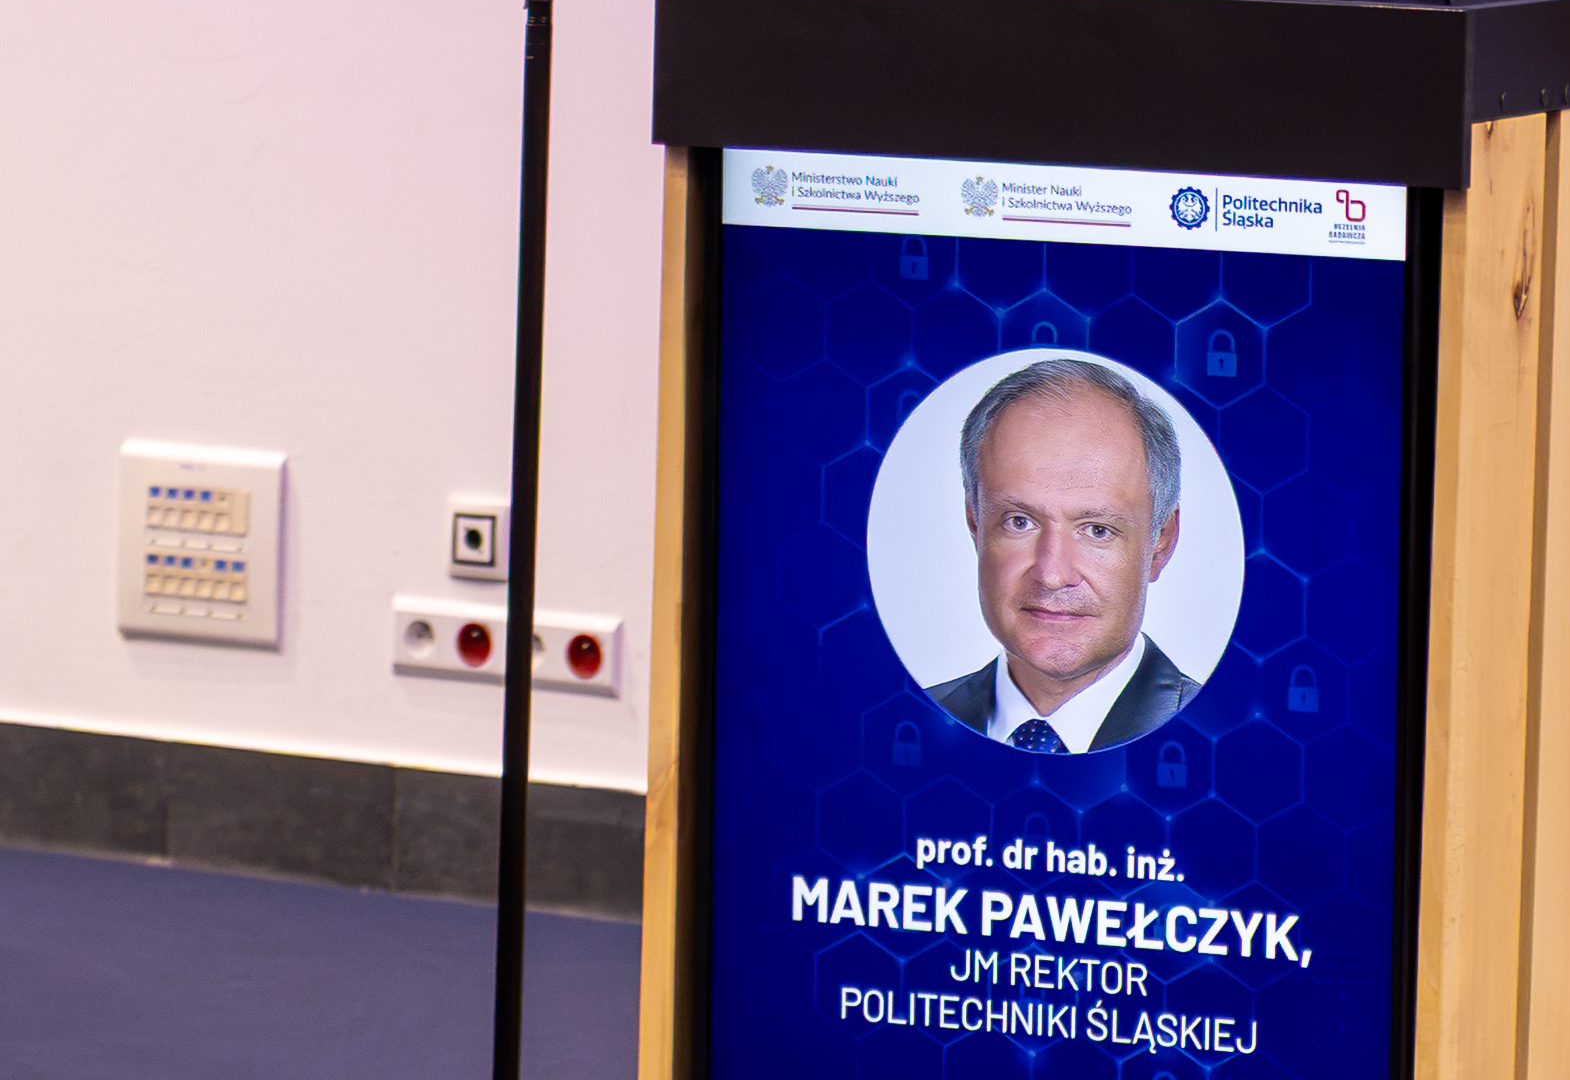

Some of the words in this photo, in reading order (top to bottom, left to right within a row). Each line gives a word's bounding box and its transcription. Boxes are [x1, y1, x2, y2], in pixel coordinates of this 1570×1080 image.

[792, 172, 862, 185] Ministerstwo
[866, 175, 898, 187] Nauki
[798, 187, 862, 200] Szkolnictwa
[864, 190, 920, 205] Wyższego
[1002, 183, 1048, 195] Minister
[1050, 185, 1083, 197] Nauki
[1008, 197, 1072, 211] Szkolnictwa
[1075, 201, 1132, 216] Wyższego
[1222, 195, 1323, 214] Politechnika
[1222, 210, 1274, 229] Śląska
[916, 835, 994, 870] prof.
[1002, 840, 1038, 871] dr
[1046, 841, 1117, 878] hab.
[1126, 846, 1185, 882] inż.
[791, 875, 969, 935] MAREK
[980, 889, 1313, 969] PAWEŁCZYK,
[950, 949, 998, 985] JM
[1009, 952, 1148, 997] REKTOR
[840, 986, 1077, 1039] POLITECHNIKI
[1086, 1000, 1258, 1054] ŚLĄSKIEJ
